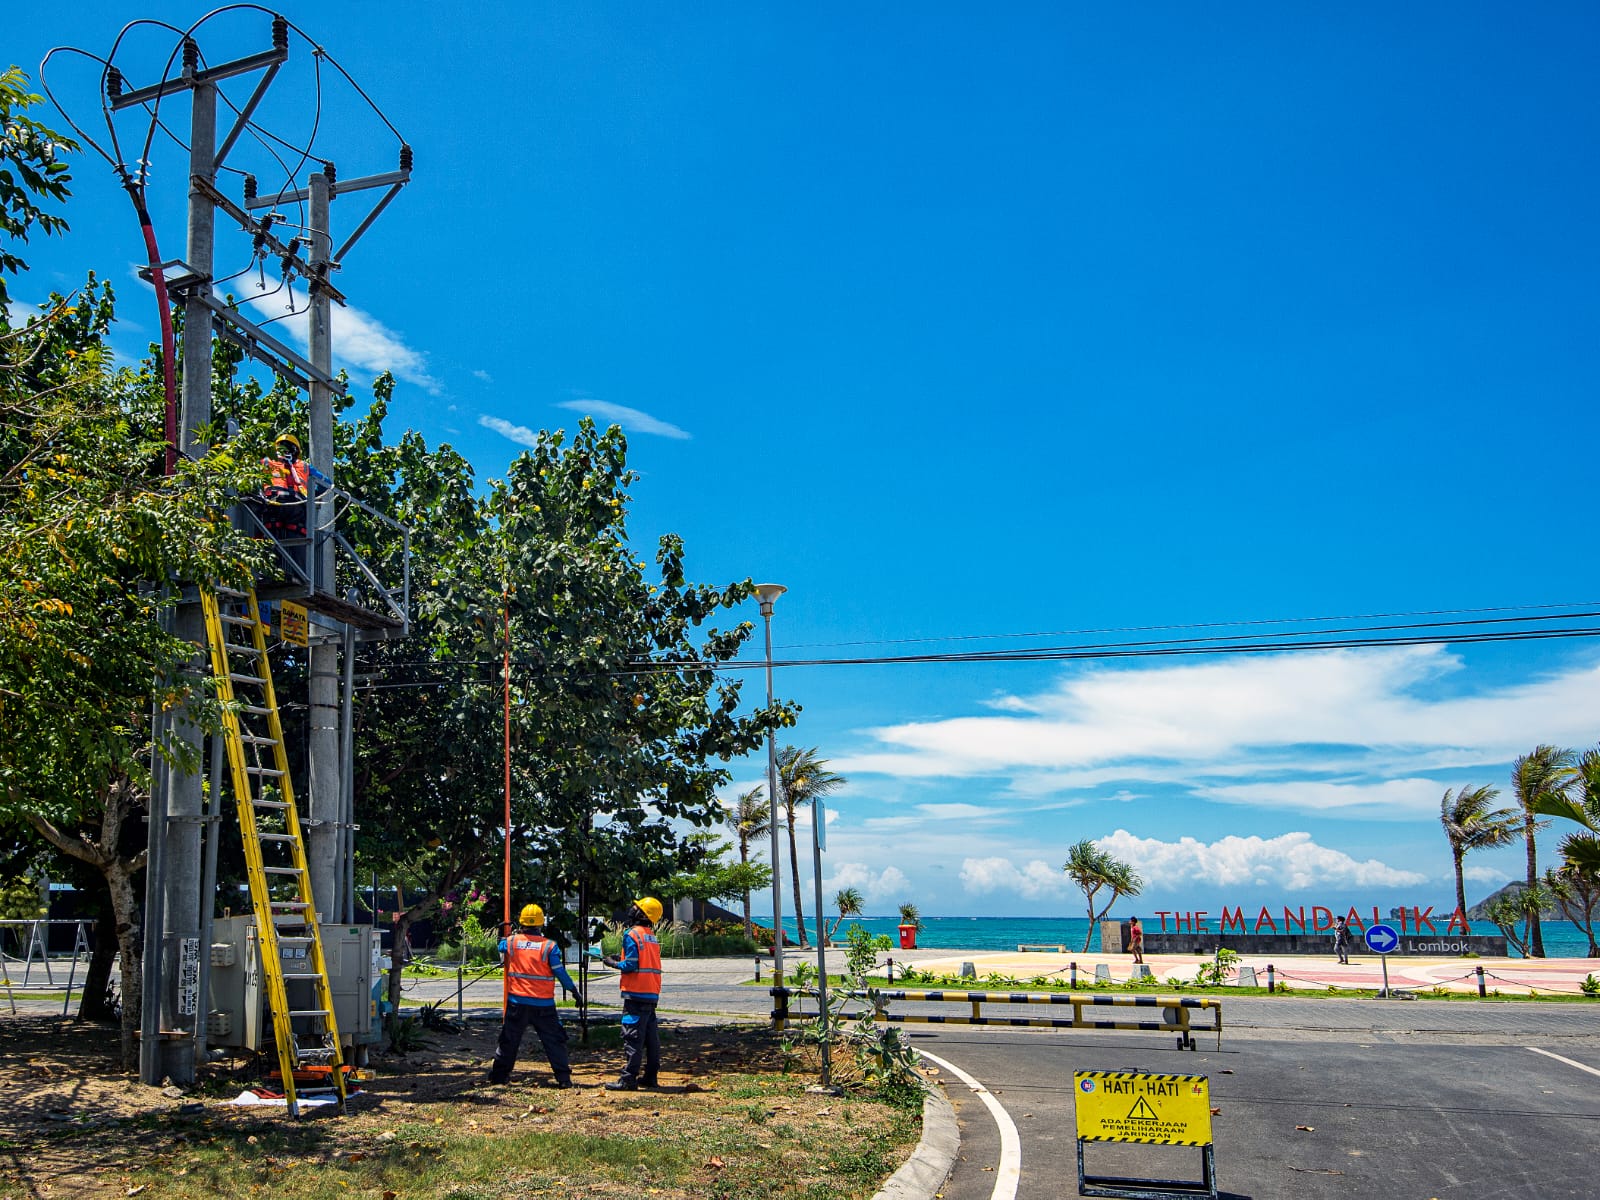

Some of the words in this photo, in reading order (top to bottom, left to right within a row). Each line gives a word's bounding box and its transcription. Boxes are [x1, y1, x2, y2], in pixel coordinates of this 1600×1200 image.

[1154, 911, 1208, 931] THE
[1409, 940, 1469, 952] Lombok
[1104, 1080, 1135, 1094] HATI
[1147, 1082, 1179, 1097] HATI
[1102, 1124, 1185, 1134] PEMELIHARAAN
[1124, 1119, 1188, 1128] PEKERJAAN
[1117, 1131, 1171, 1139] JARINGAN
